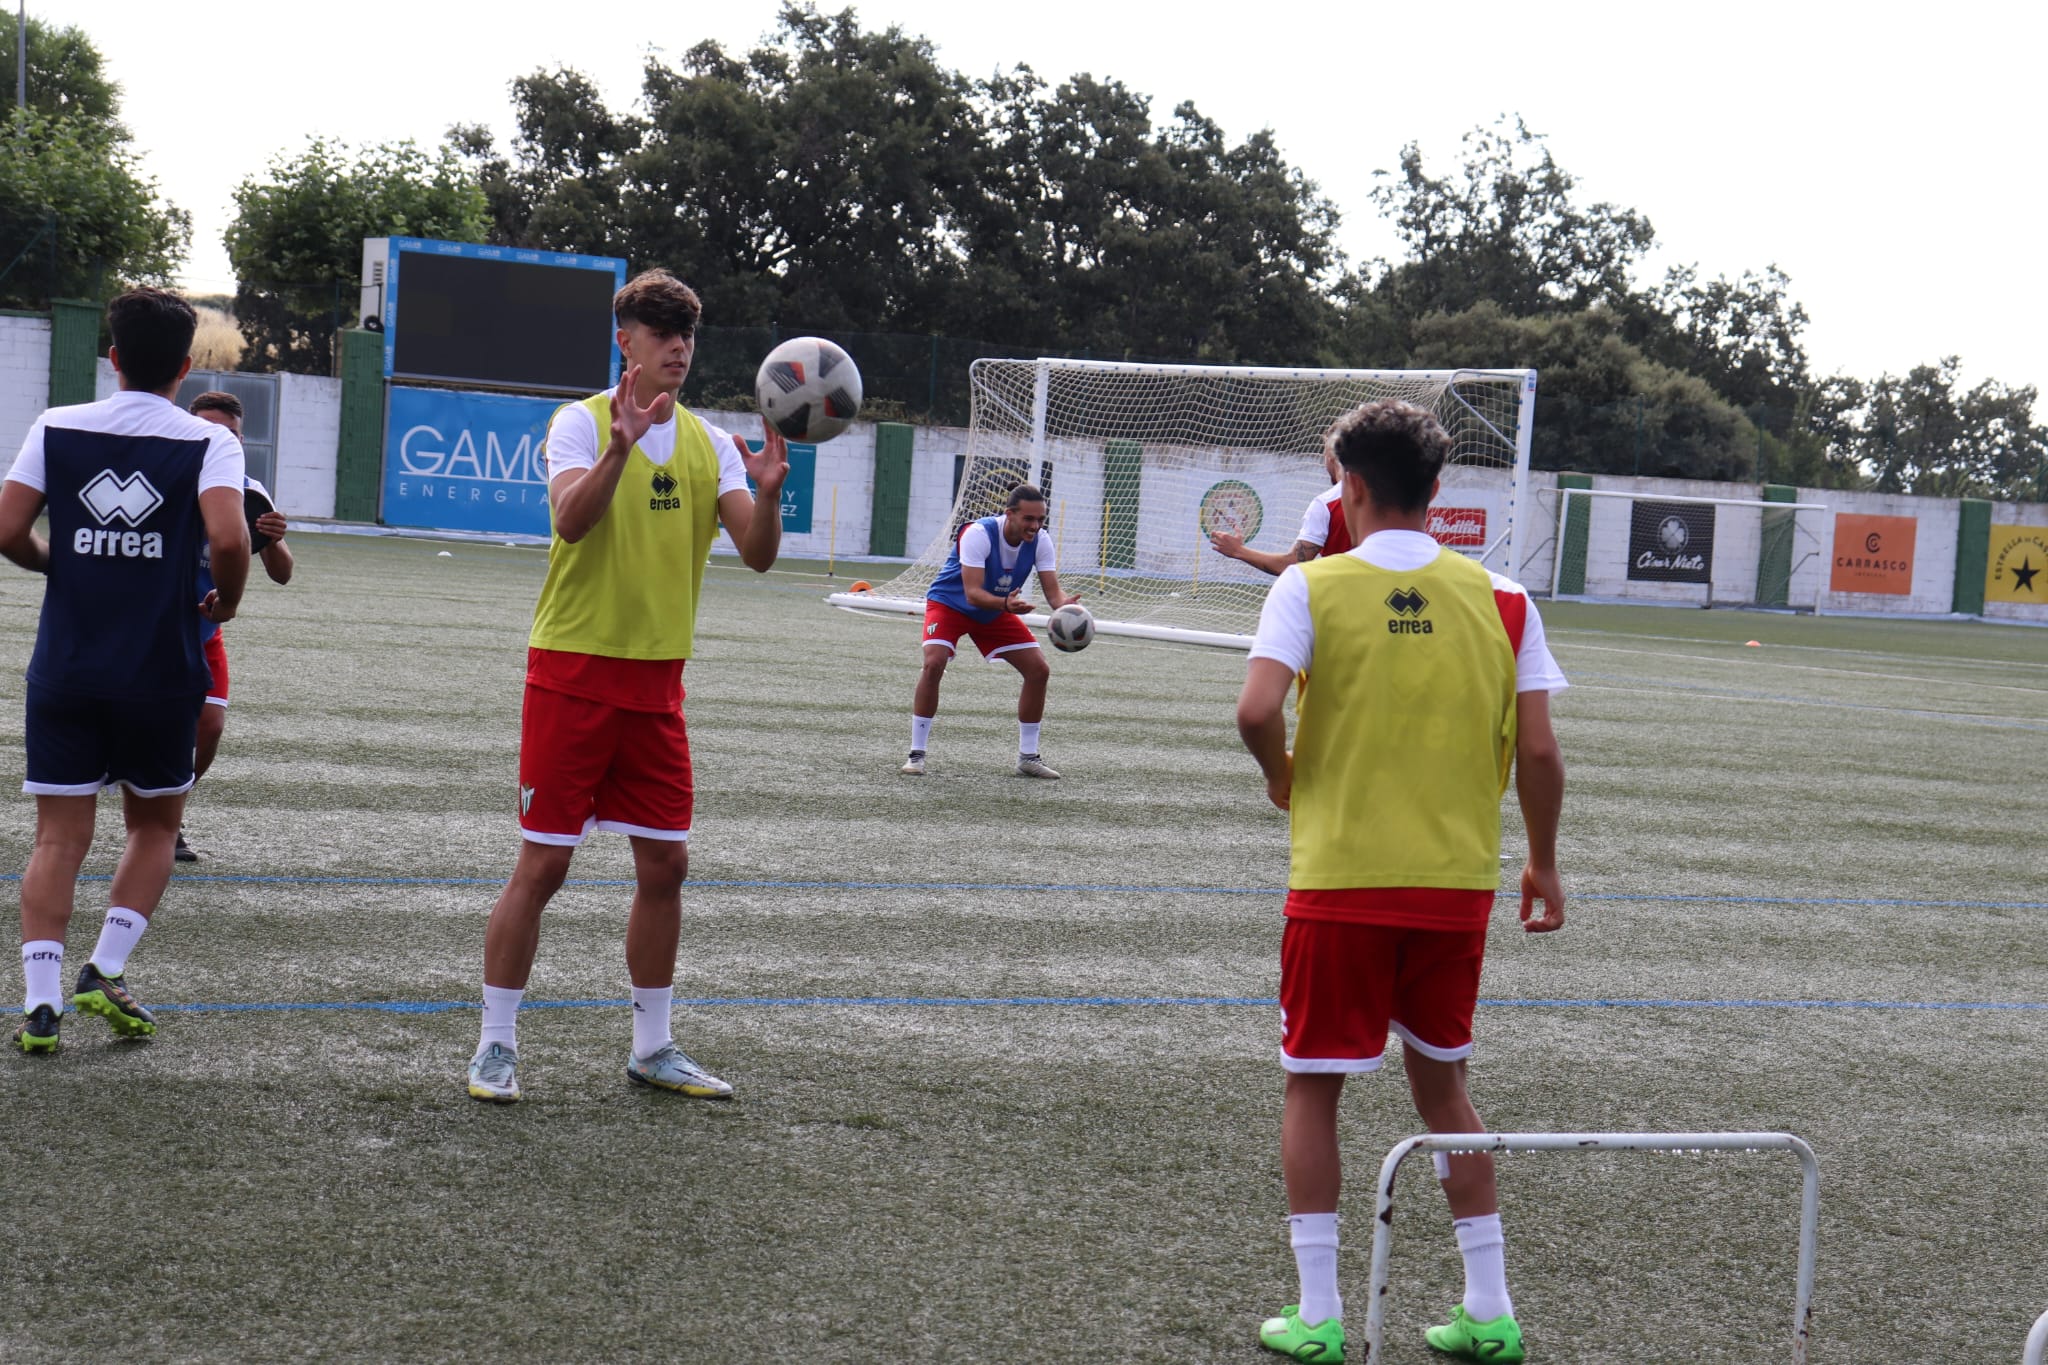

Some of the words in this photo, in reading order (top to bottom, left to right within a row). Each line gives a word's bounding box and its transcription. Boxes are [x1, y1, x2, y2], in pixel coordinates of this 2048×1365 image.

[649, 497, 681, 511] errea
[780, 504, 798, 517] EZ
[73, 527, 163, 559] errea
[1836, 556, 1907, 571] CARRASCO
[1387, 618, 1433, 635] errea
[32, 951, 62, 963] erre
